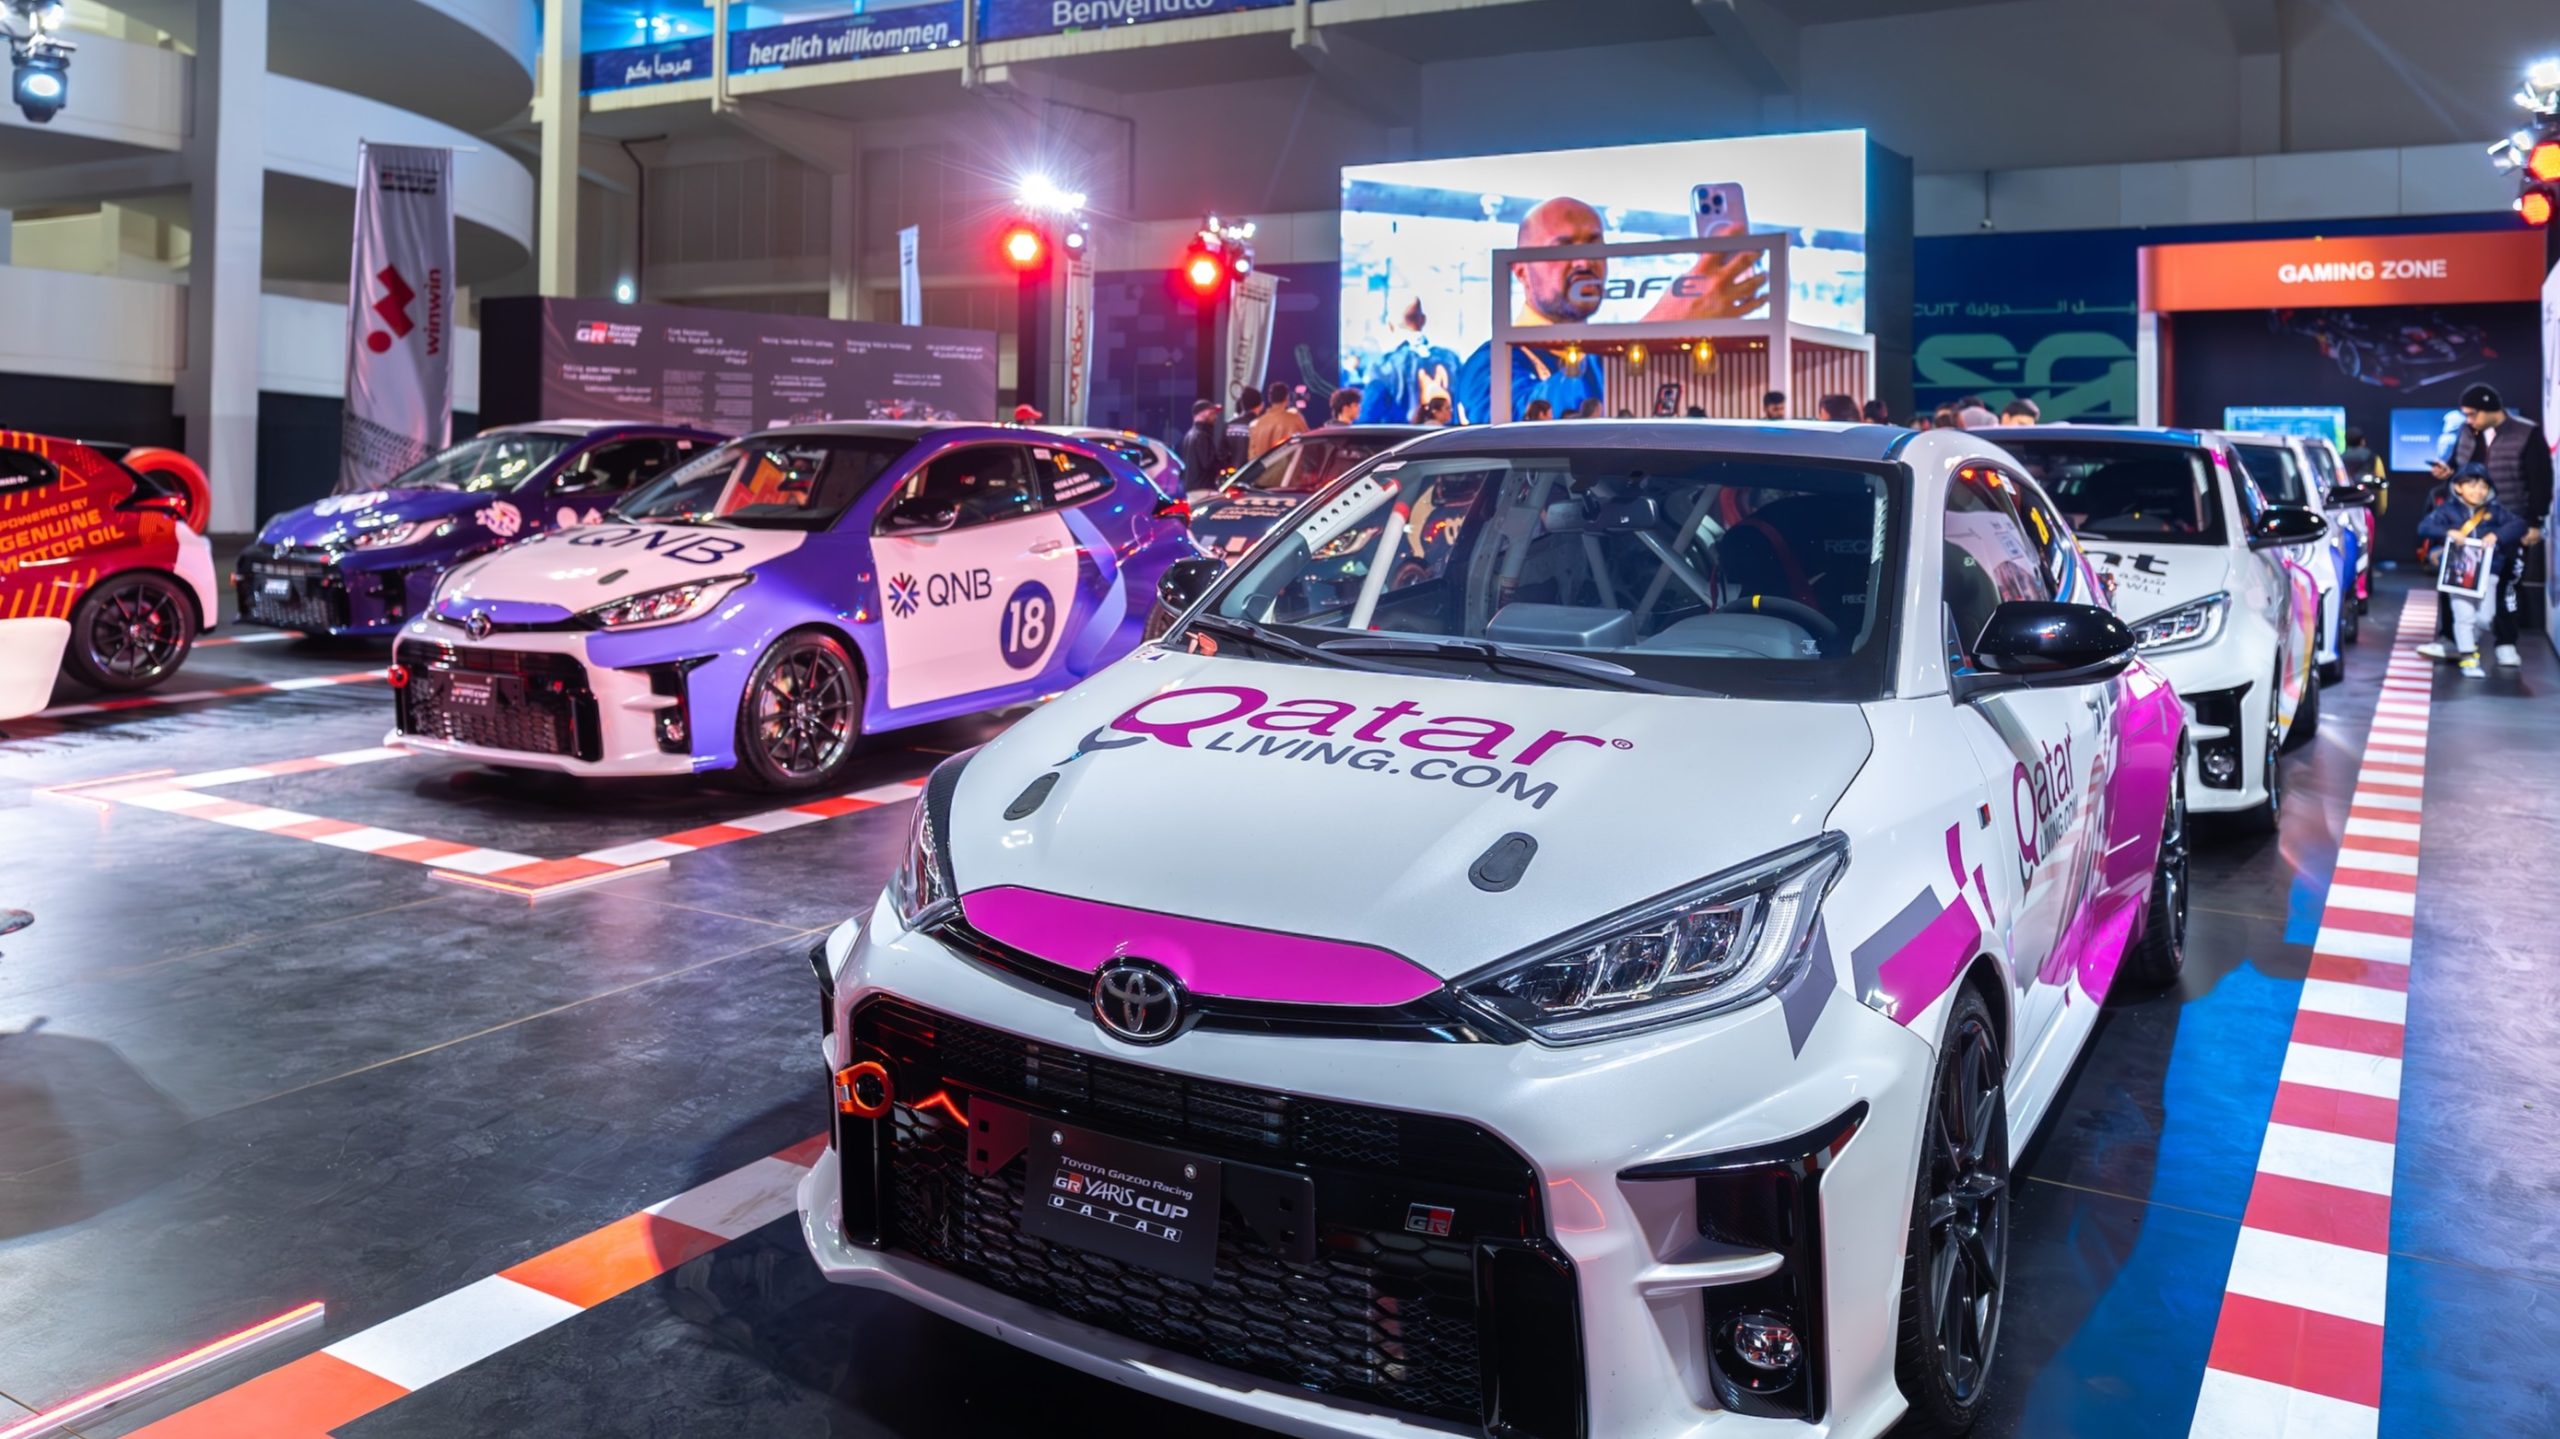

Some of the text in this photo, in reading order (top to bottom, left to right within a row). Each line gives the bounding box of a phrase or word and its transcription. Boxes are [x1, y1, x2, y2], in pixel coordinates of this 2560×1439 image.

[748, 22, 948, 66] herzlich willkommen
[2278, 258, 2447, 284] GAMING ZONE
[424, 268, 442, 356] winwin
[0, 508, 102, 553] GENUINE
[0, 525, 125, 574] MOTOR OIL
[568, 527, 746, 564] QNB
[927, 568, 993, 608] QNB
[1009, 597, 1046, 653] 18
[1204, 731, 1559, 810] LIVING.COM
[1055, 1176, 1081, 1193] GR
[1136, 1196, 1190, 1220] CUP
[1060, 1155, 1194, 1201] TOYOTA GAZOO Racing
